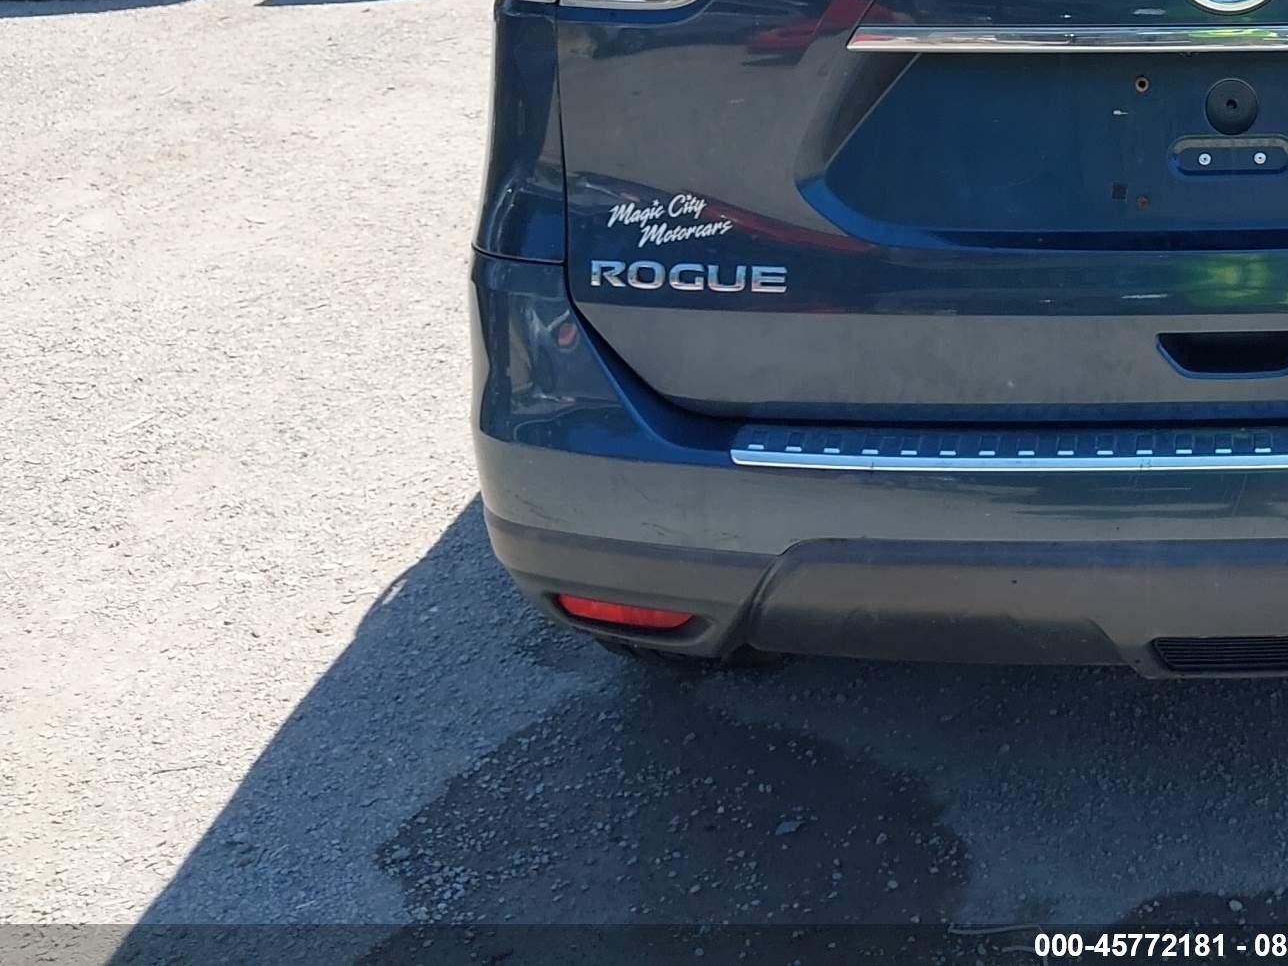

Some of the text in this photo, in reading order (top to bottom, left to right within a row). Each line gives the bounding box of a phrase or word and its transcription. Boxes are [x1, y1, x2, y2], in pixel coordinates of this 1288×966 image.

[606, 193, 708, 229] Magic City
[637, 216, 734, 249] Motorcars
[590, 259, 788, 294] ROGUE
